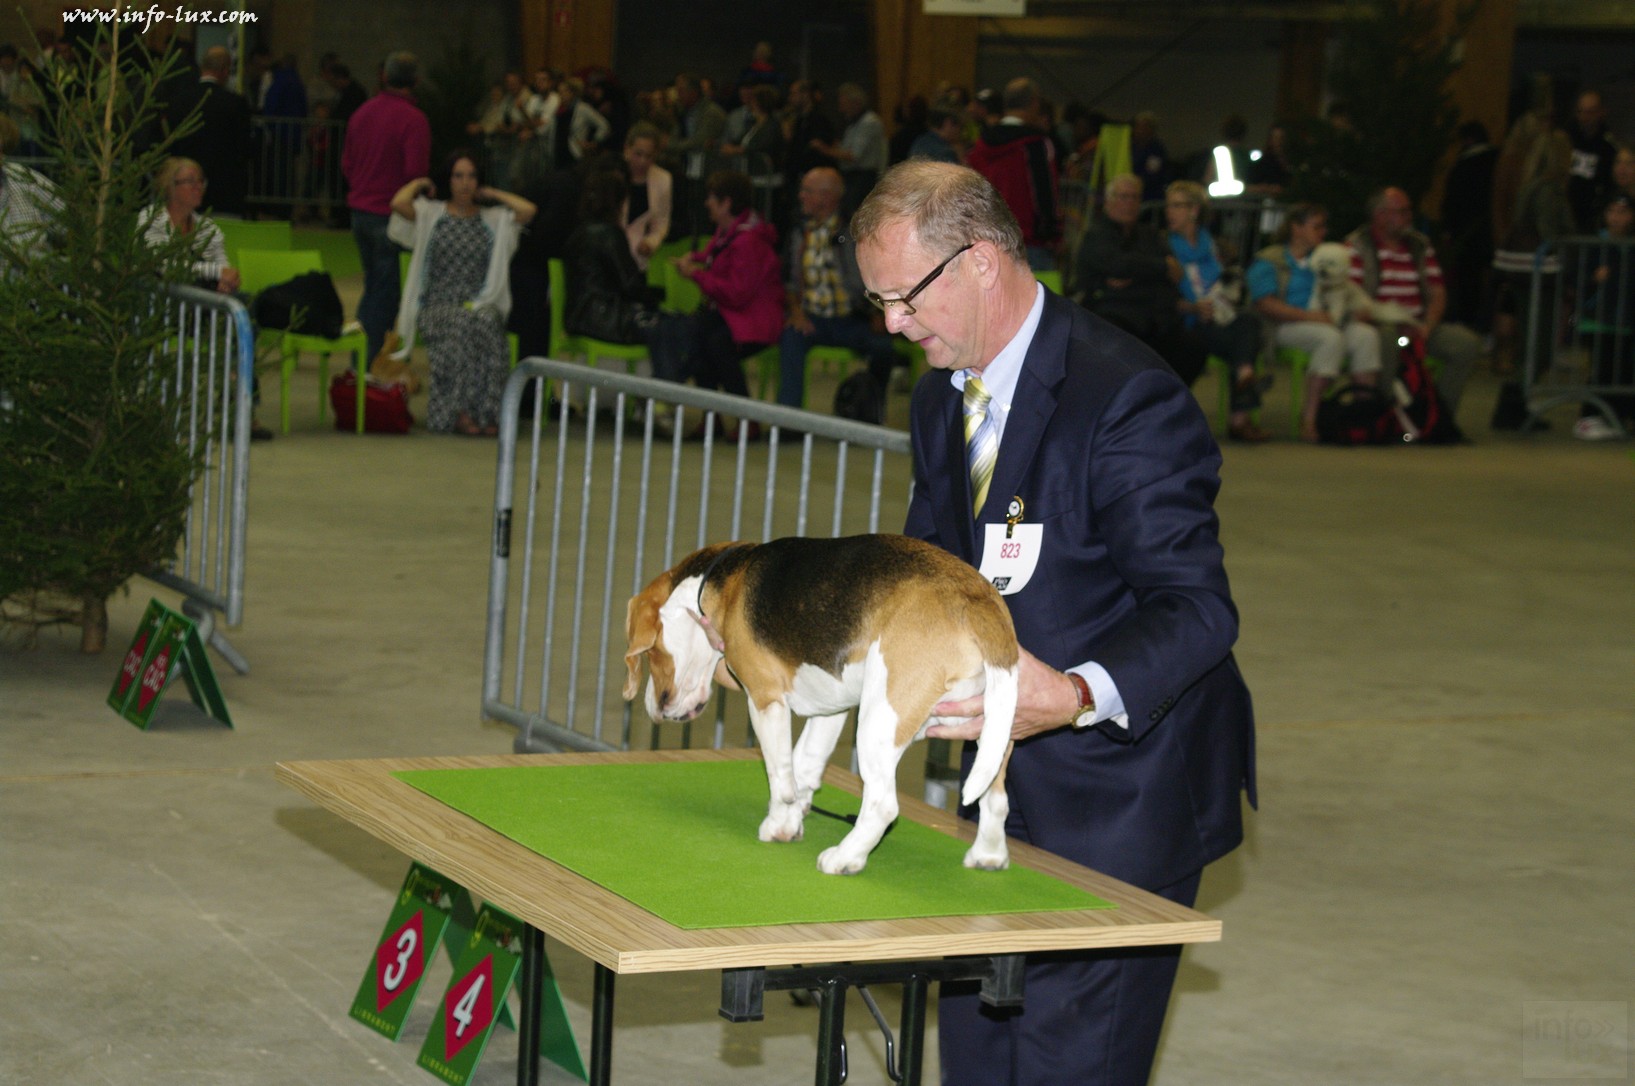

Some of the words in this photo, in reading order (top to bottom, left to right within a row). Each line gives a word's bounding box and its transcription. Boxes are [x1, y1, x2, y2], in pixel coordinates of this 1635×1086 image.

[1000, 543, 1021, 558] 823
[384, 928, 417, 990] 3
[453, 973, 486, 1037] 4
